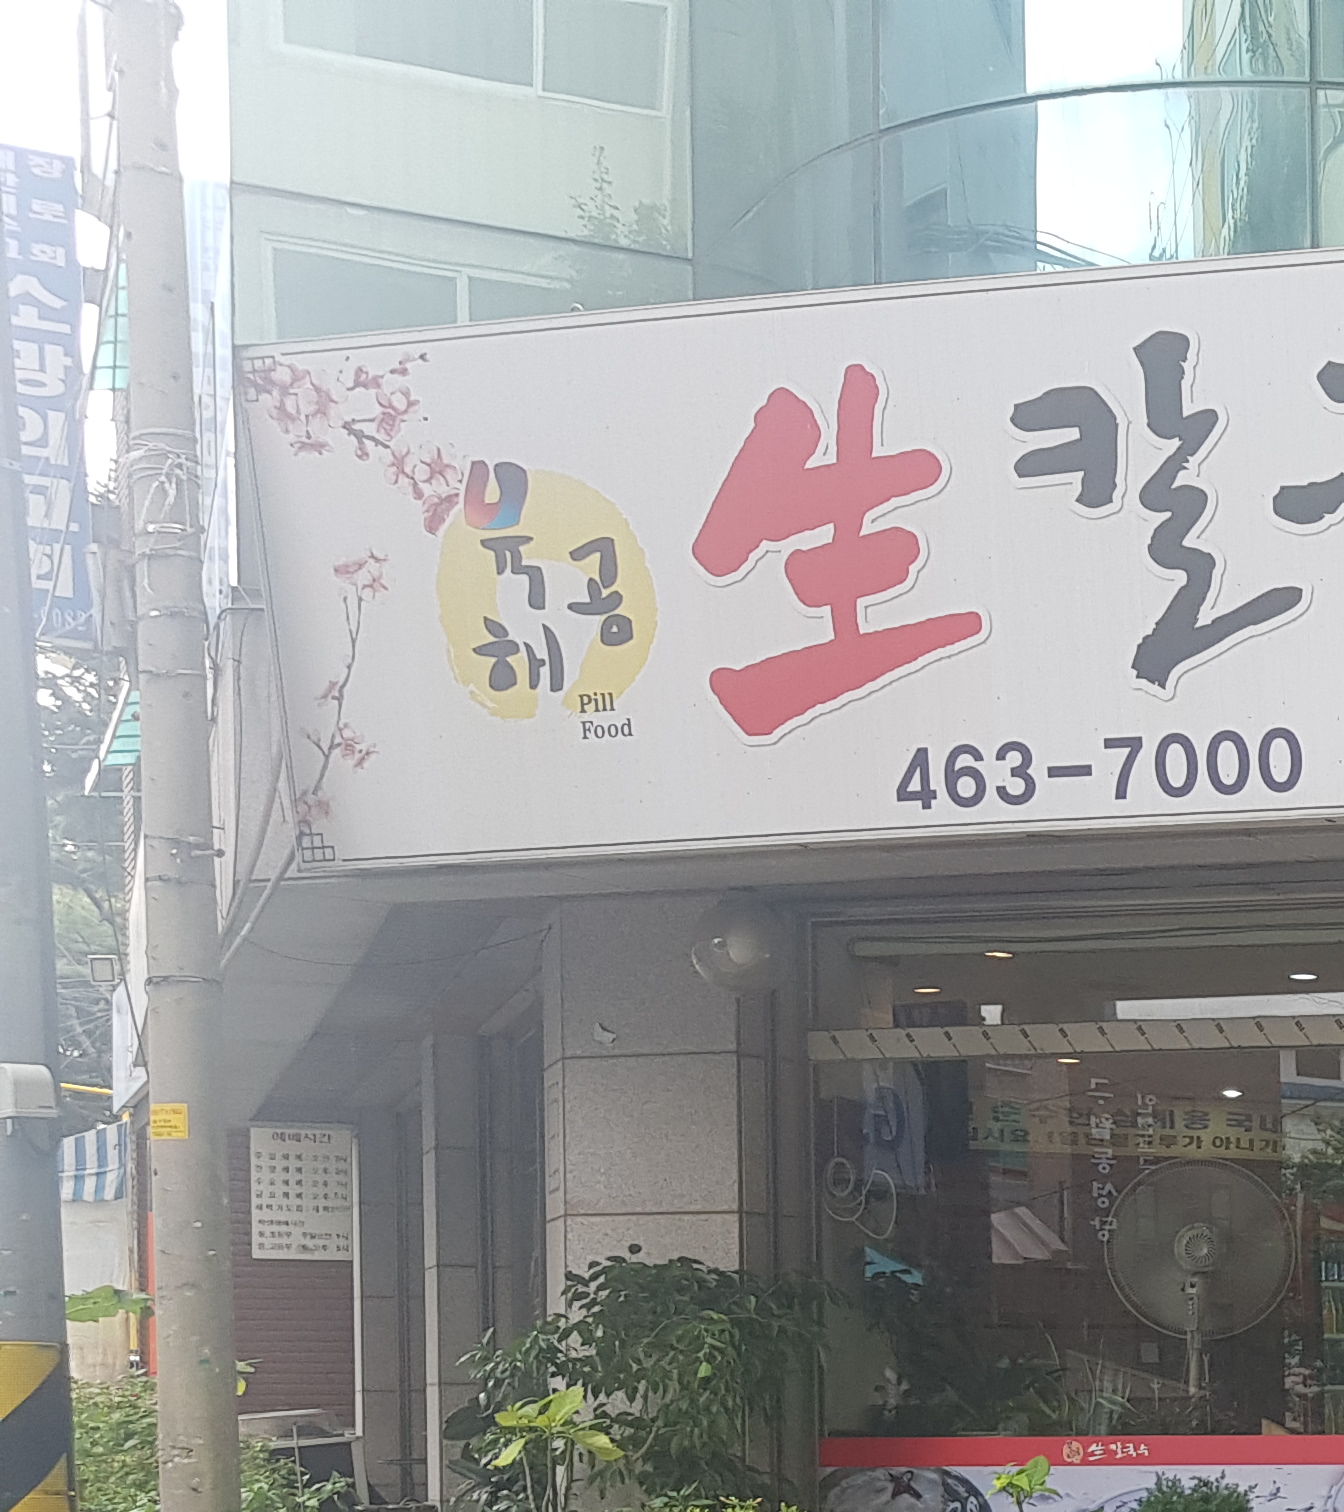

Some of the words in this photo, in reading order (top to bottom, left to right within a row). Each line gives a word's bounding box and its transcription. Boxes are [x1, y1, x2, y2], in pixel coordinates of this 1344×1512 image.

[578, 691, 617, 714] Pill
[580, 717, 634, 741] Food
[895, 725, 1304, 810] 463-7000
